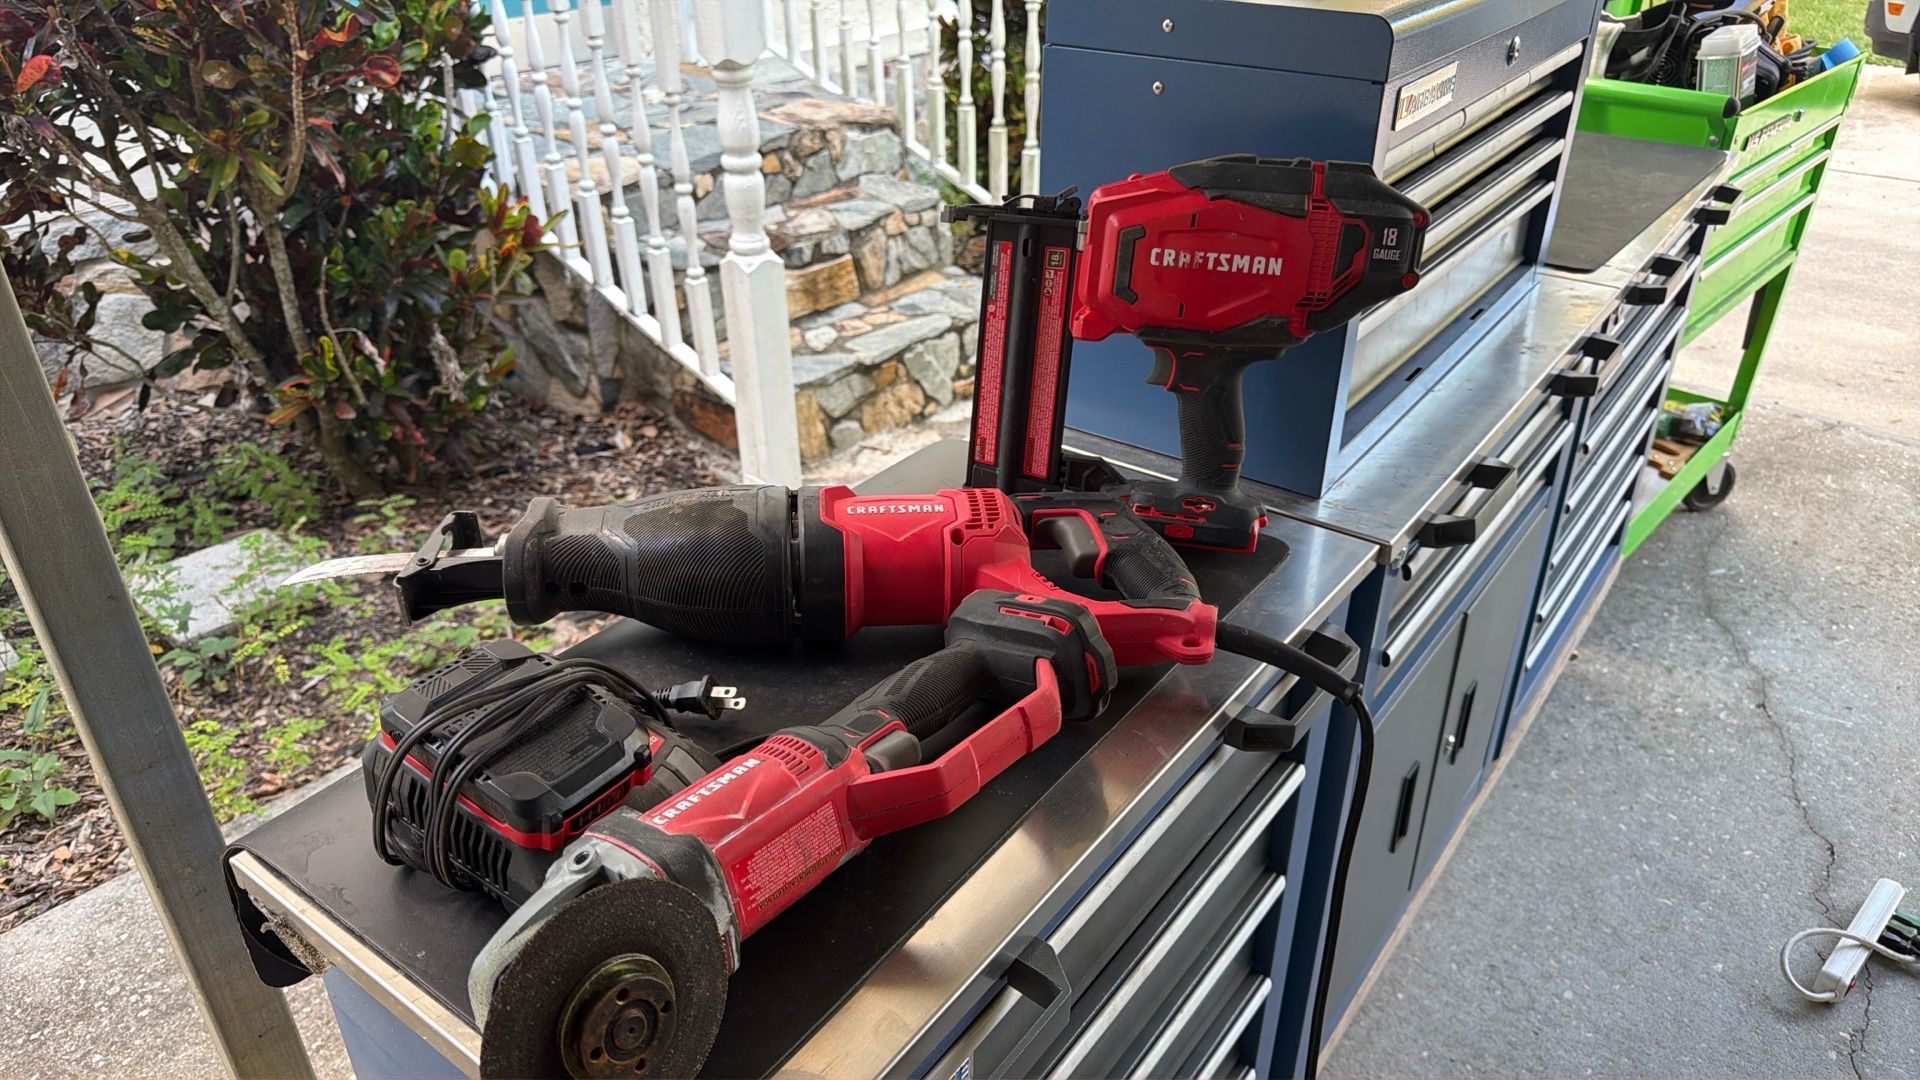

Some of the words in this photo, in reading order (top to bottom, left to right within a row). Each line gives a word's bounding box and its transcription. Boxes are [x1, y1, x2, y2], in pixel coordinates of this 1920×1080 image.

[1382, 227, 1398, 246] 18
[1150, 247, 1283, 276] CRAFTSMAN
[1373, 248, 1401, 261] GAUGE
[846, 504, 945, 515] CRAFTSMAN
[651, 757, 761, 826] CRAFTSMAN
